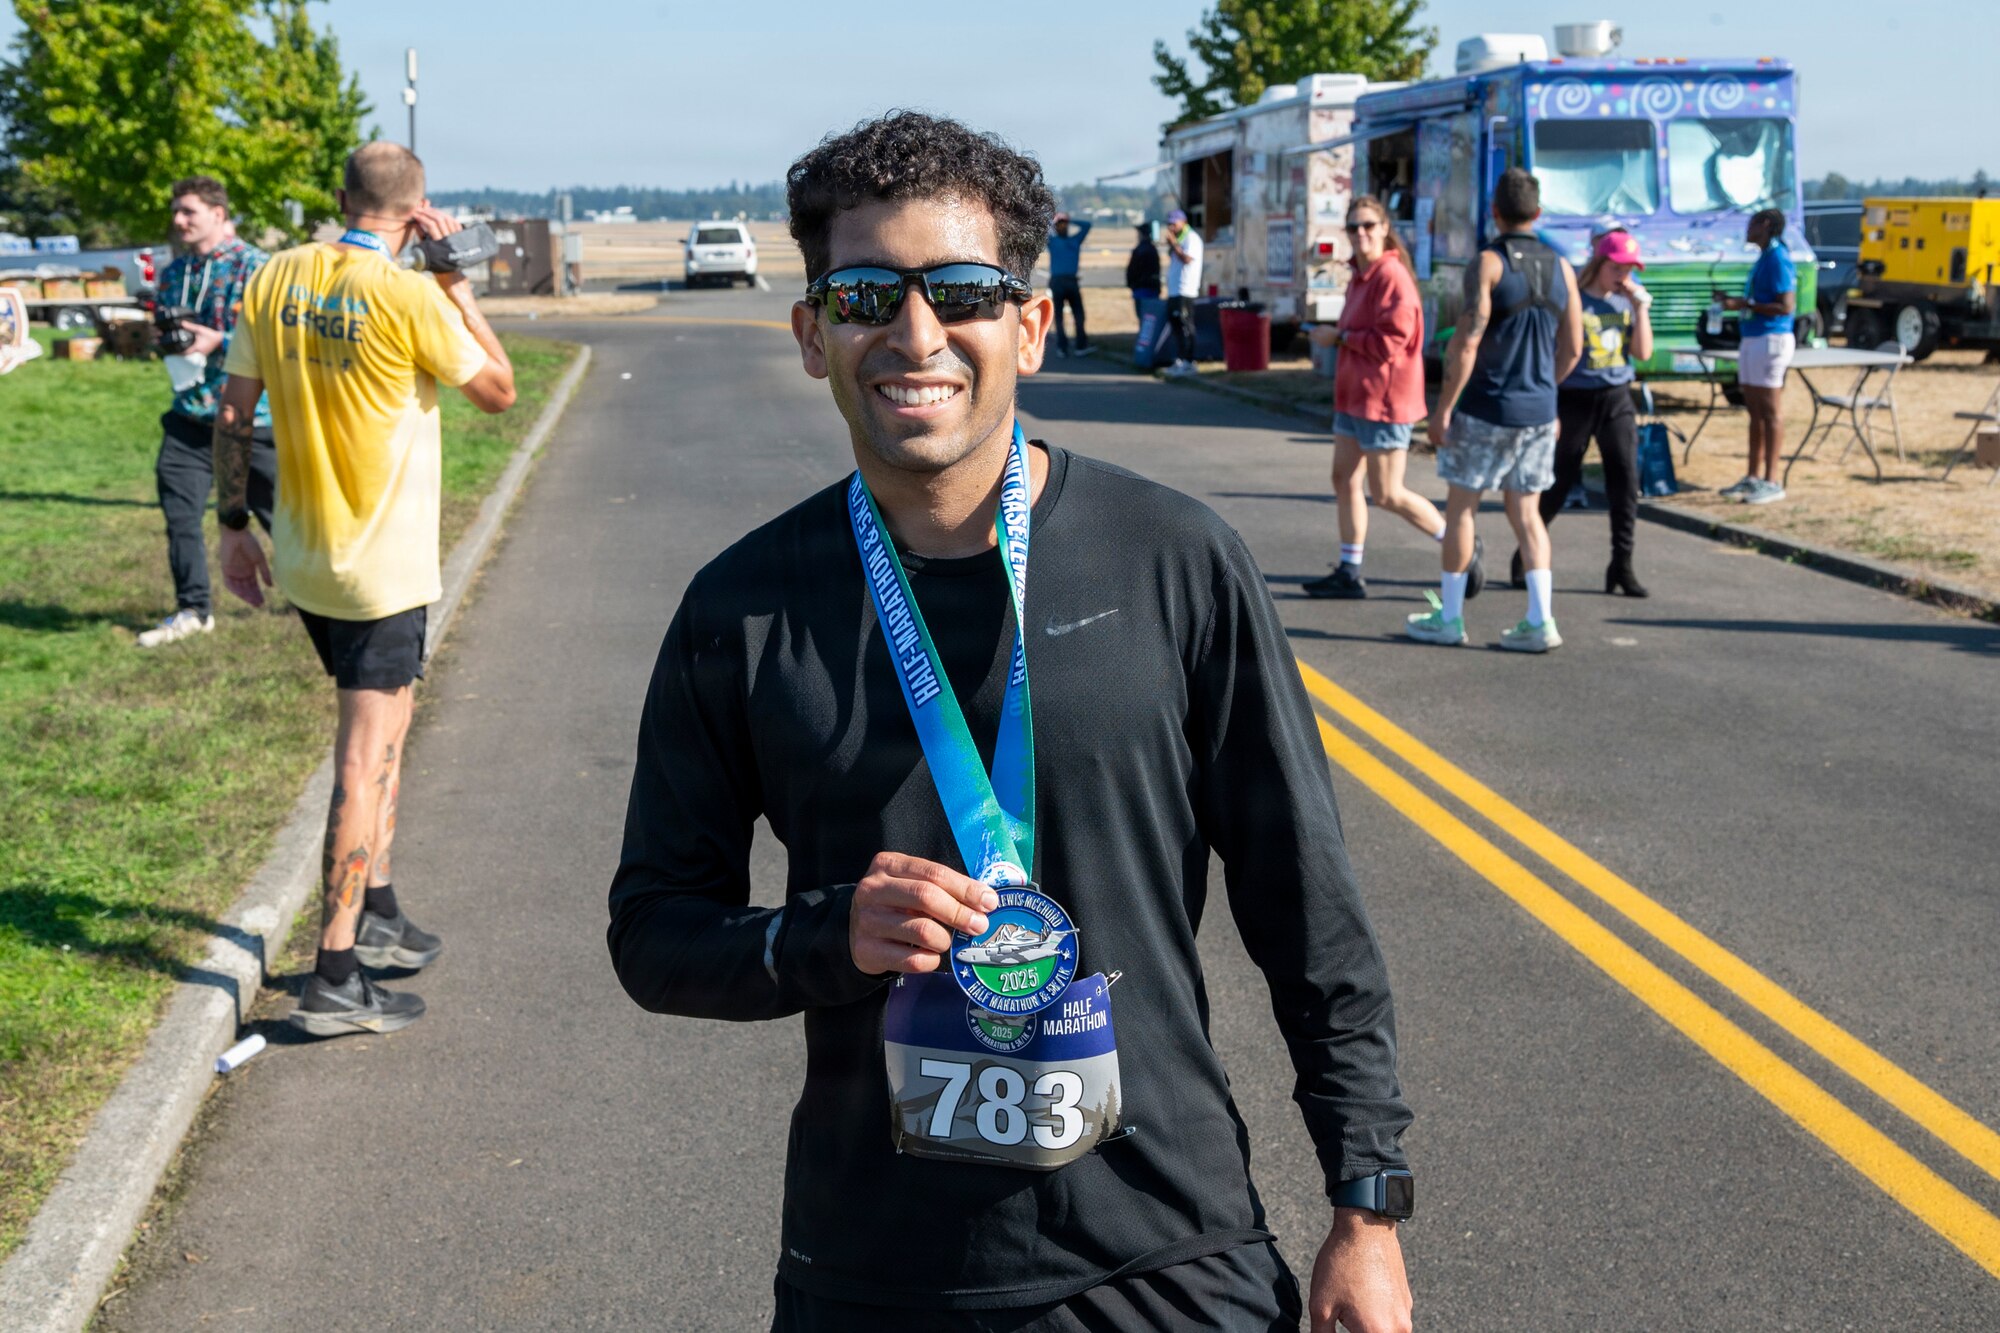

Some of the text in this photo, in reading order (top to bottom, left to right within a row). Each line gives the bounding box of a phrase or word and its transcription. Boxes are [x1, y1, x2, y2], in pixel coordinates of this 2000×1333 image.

[1001, 488, 1028, 541] BASE
[863, 525, 879, 551] &
[868, 543, 940, 706] HALF-MARATHON
[1000, 967, 1038, 993] 2025
[967, 981, 992, 1003] HALF
[989, 994, 1041, 1012] MARATHON
[1039, 991, 1051, 1002] &
[1063, 997, 1092, 1018] HALF
[991, 1025, 1013, 1039] 2025
[1043, 1010, 1107, 1036] MARATHON
[920, 1057, 1085, 1150] 783
